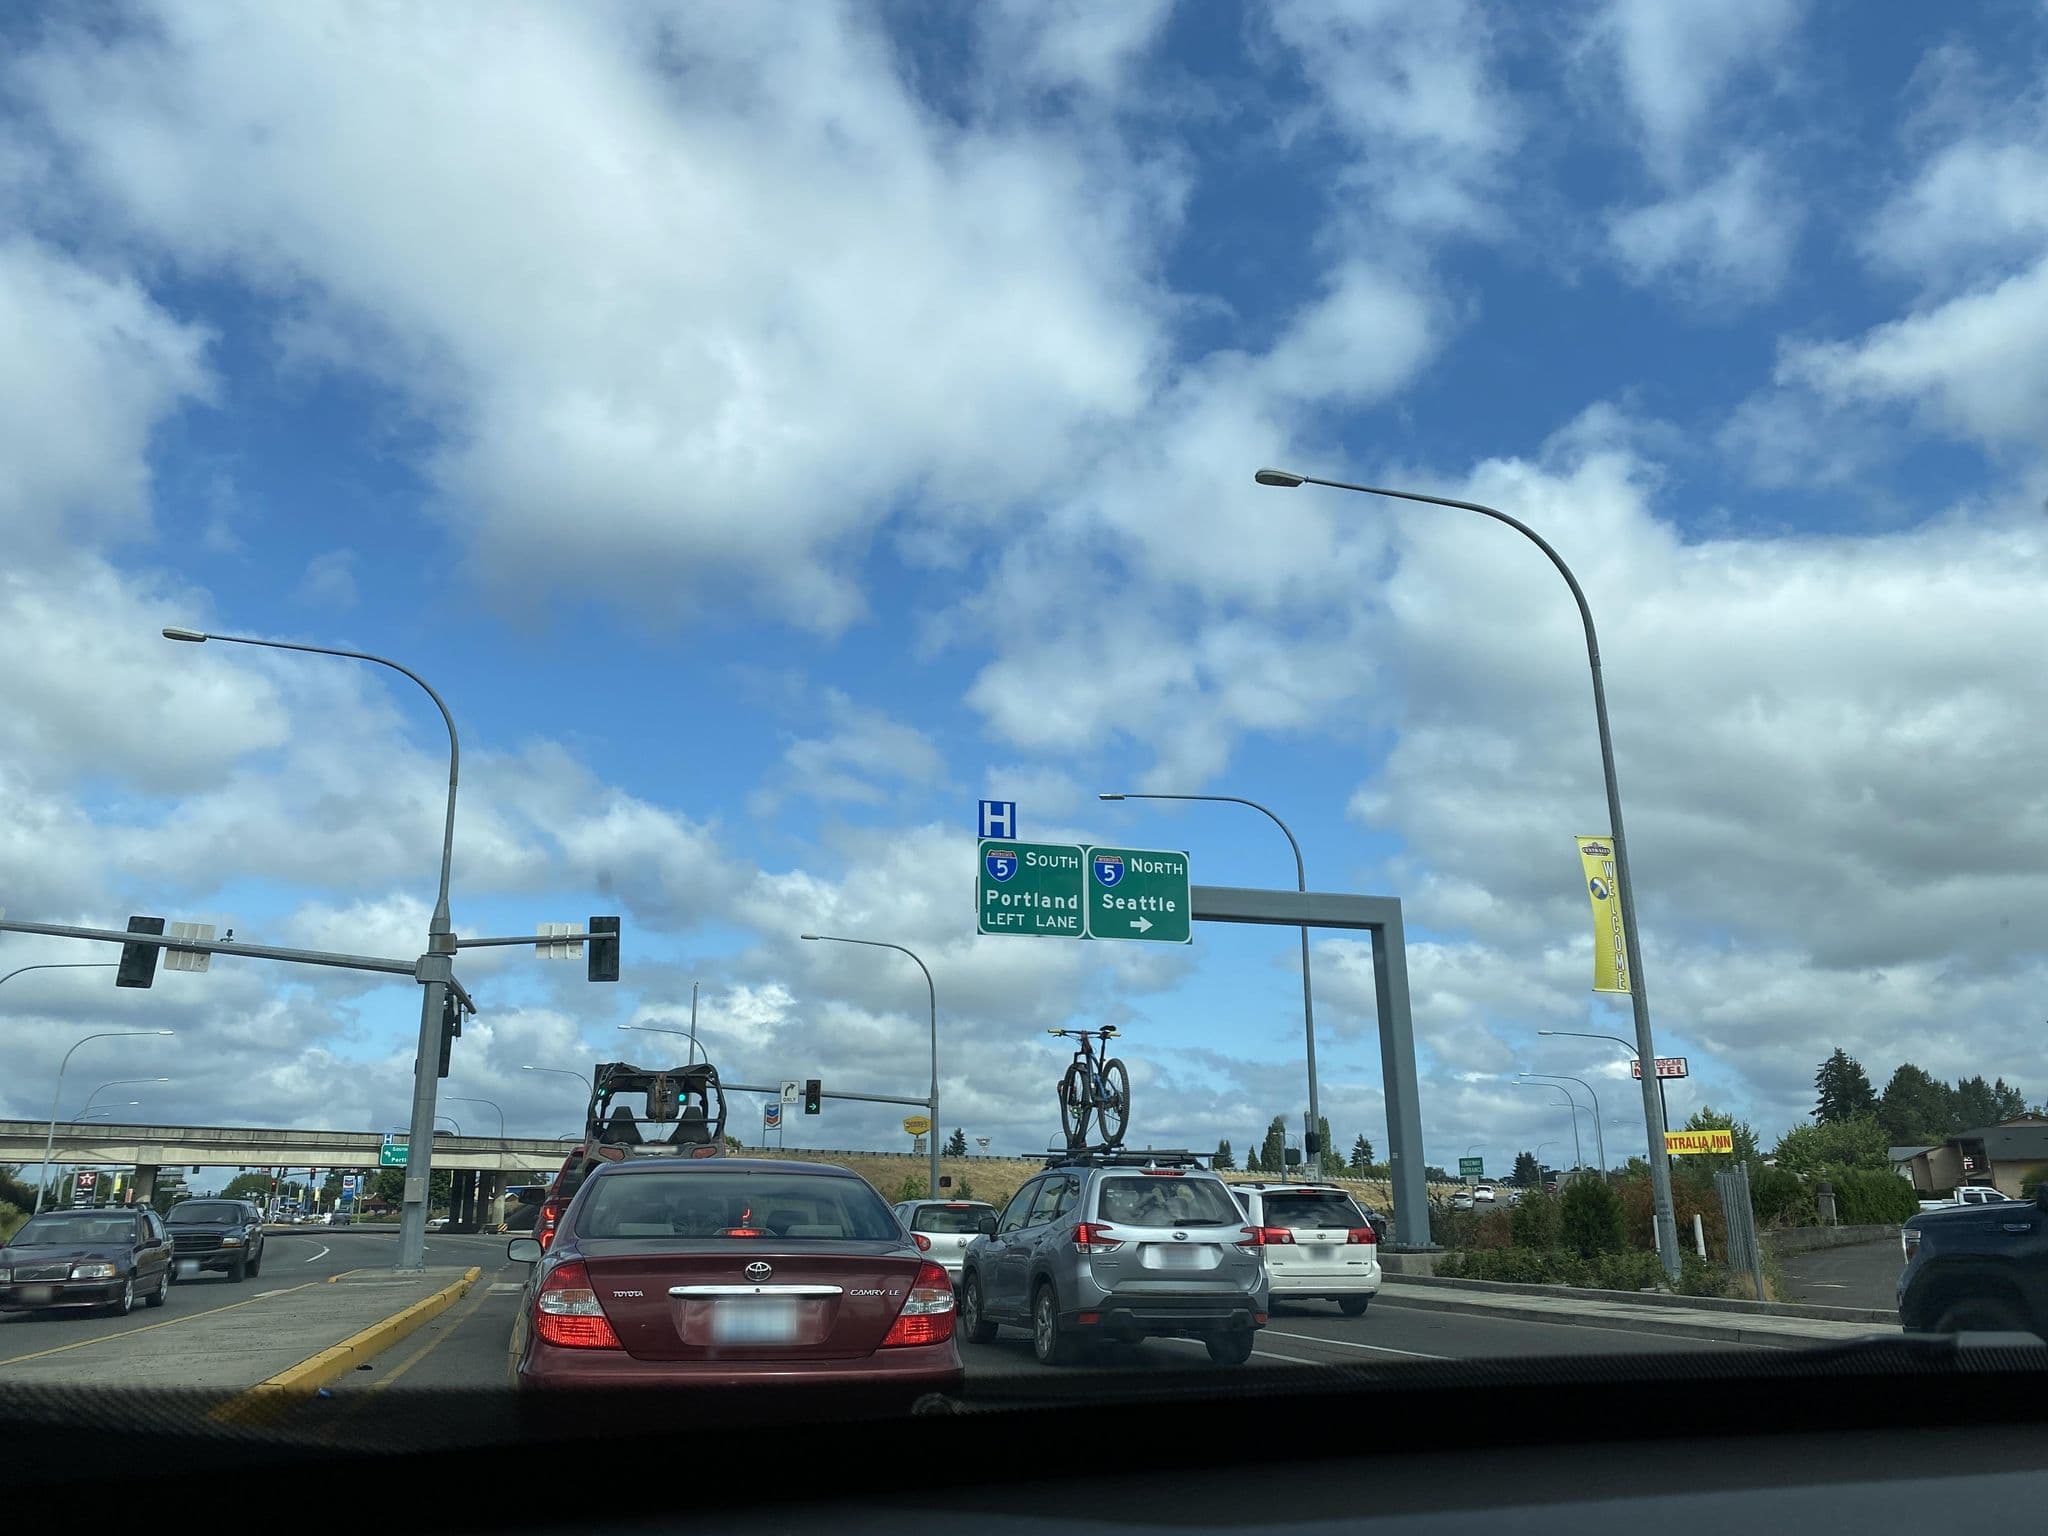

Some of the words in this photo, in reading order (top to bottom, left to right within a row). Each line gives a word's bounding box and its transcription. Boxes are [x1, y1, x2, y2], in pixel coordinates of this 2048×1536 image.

[983, 802, 1011, 837] H
[996, 859, 1009, 877] 5
[1103, 864, 1116, 882] 5
[986, 889, 1078, 909] Portland
[1102, 893, 1176, 912] Seattle
[987, 912, 1025, 926] LEFT
[1036, 914, 1078, 929] LANE
[1602, 861, 1626, 990] WELCOME
[1655, 1059, 1682, 1067] OSCAR
[383, 1134, 392, 1144] H
[1711, 1134, 1732, 1149] INN
[613, 1290, 644, 1298] TOYOTA
